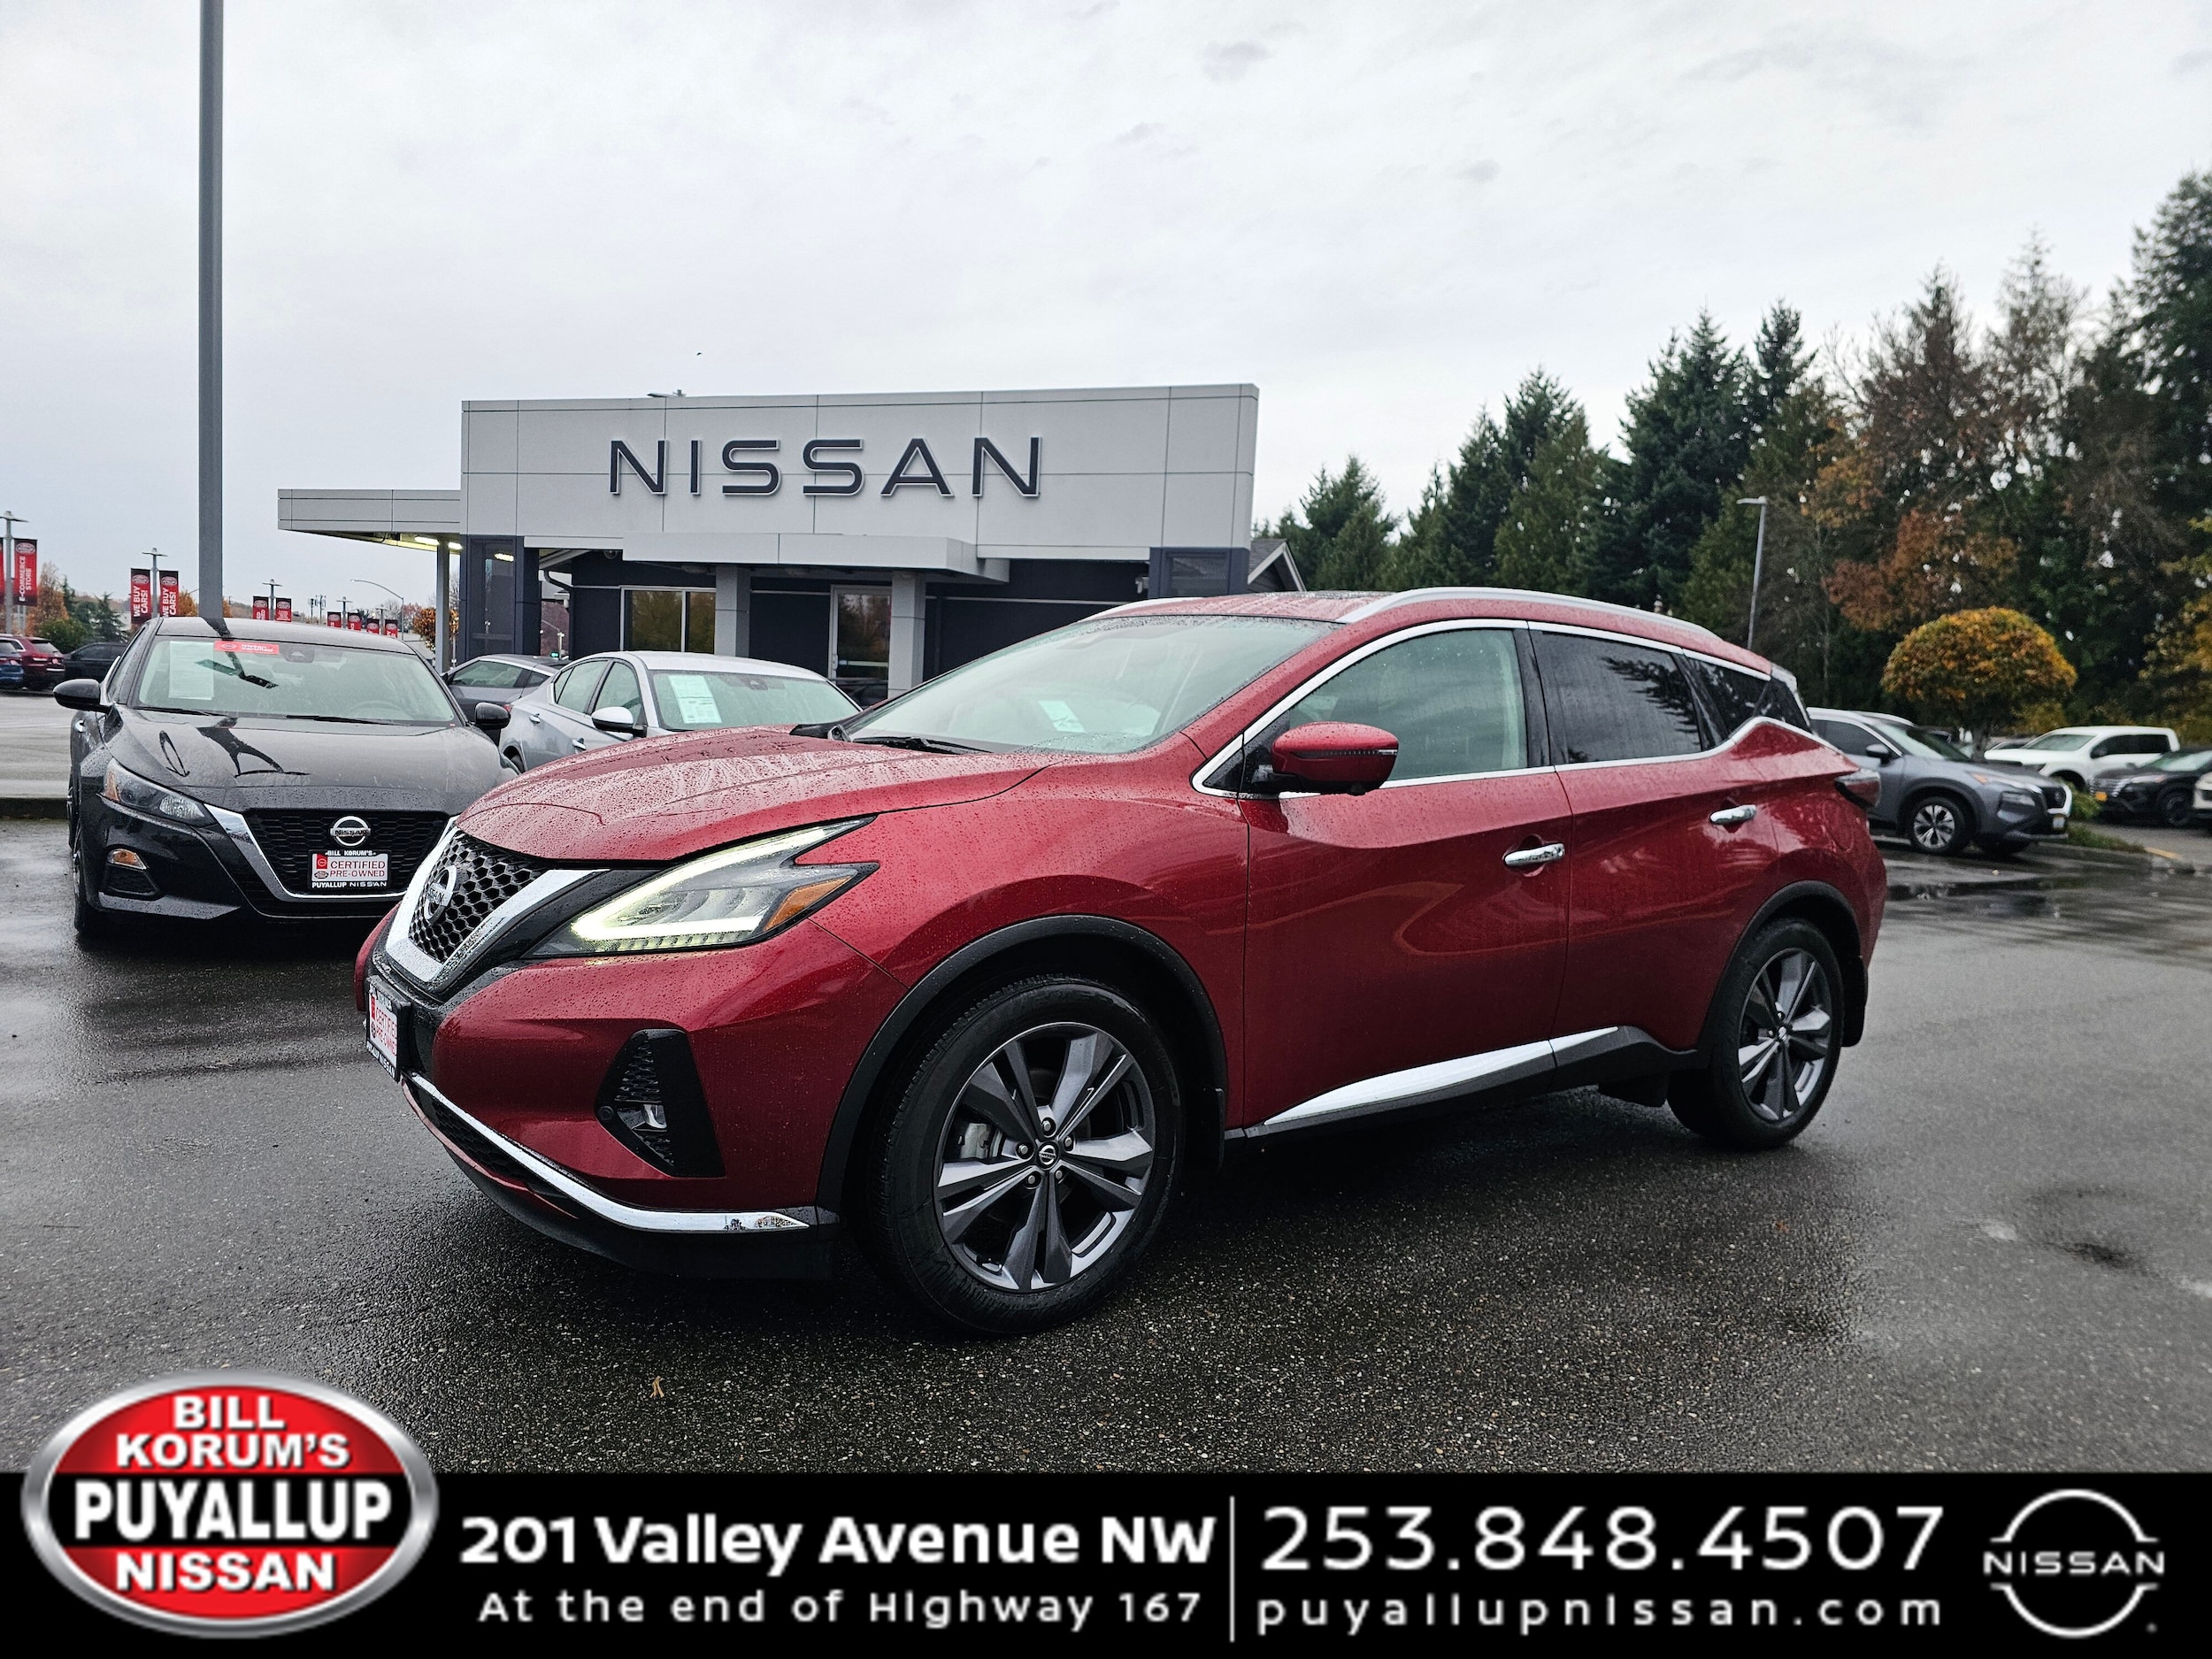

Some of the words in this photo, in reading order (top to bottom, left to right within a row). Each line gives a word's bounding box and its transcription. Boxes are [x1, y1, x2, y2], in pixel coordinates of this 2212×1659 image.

[610, 438, 1041, 496] NISSAN
[133, 604, 141, 618] WE
[162, 605, 169, 618] WE
[330, 860, 386, 869] CERTIFIED
